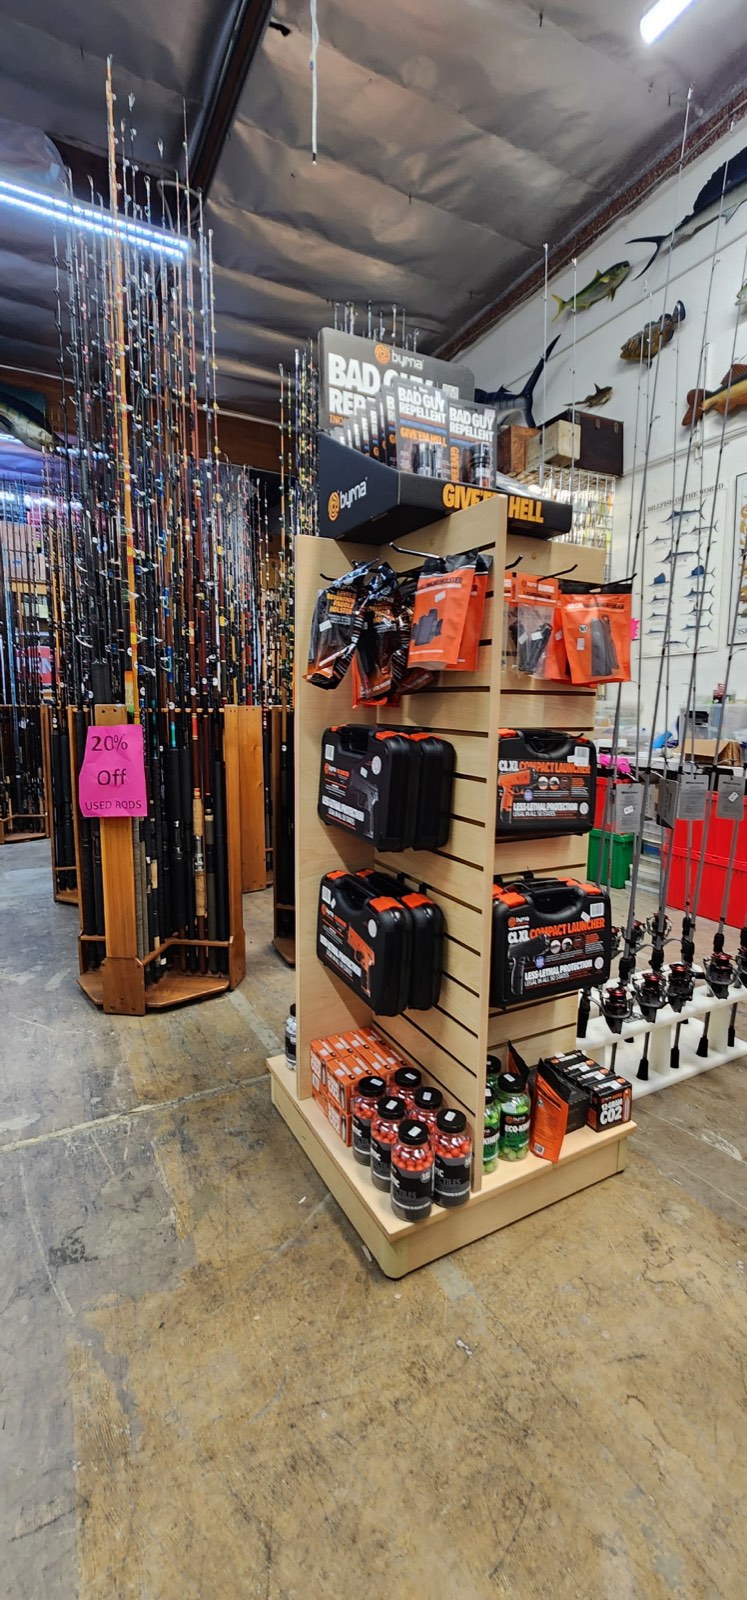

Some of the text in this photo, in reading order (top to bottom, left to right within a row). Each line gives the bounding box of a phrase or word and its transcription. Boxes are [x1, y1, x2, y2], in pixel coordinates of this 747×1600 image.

[392, 350, 423, 370] byrna
[328, 352, 381, 397] BAD
[398, 386, 445, 412] BAD GUY
[399, 402, 446, 424] REPELLENT
[449, 406, 495, 431] BAD GUY
[449, 422, 495, 443] REPELLENT
[340, 480, 367, 509] byrna
[508, 495, 544, 523] HELL
[91, 733, 129, 752] 20%
[97, 768, 127, 786] Off
[85, 799, 142, 811] USED RODS
[529, 924, 568, 939] COMPACT
[568, 918, 605, 933] LAUNCHER
